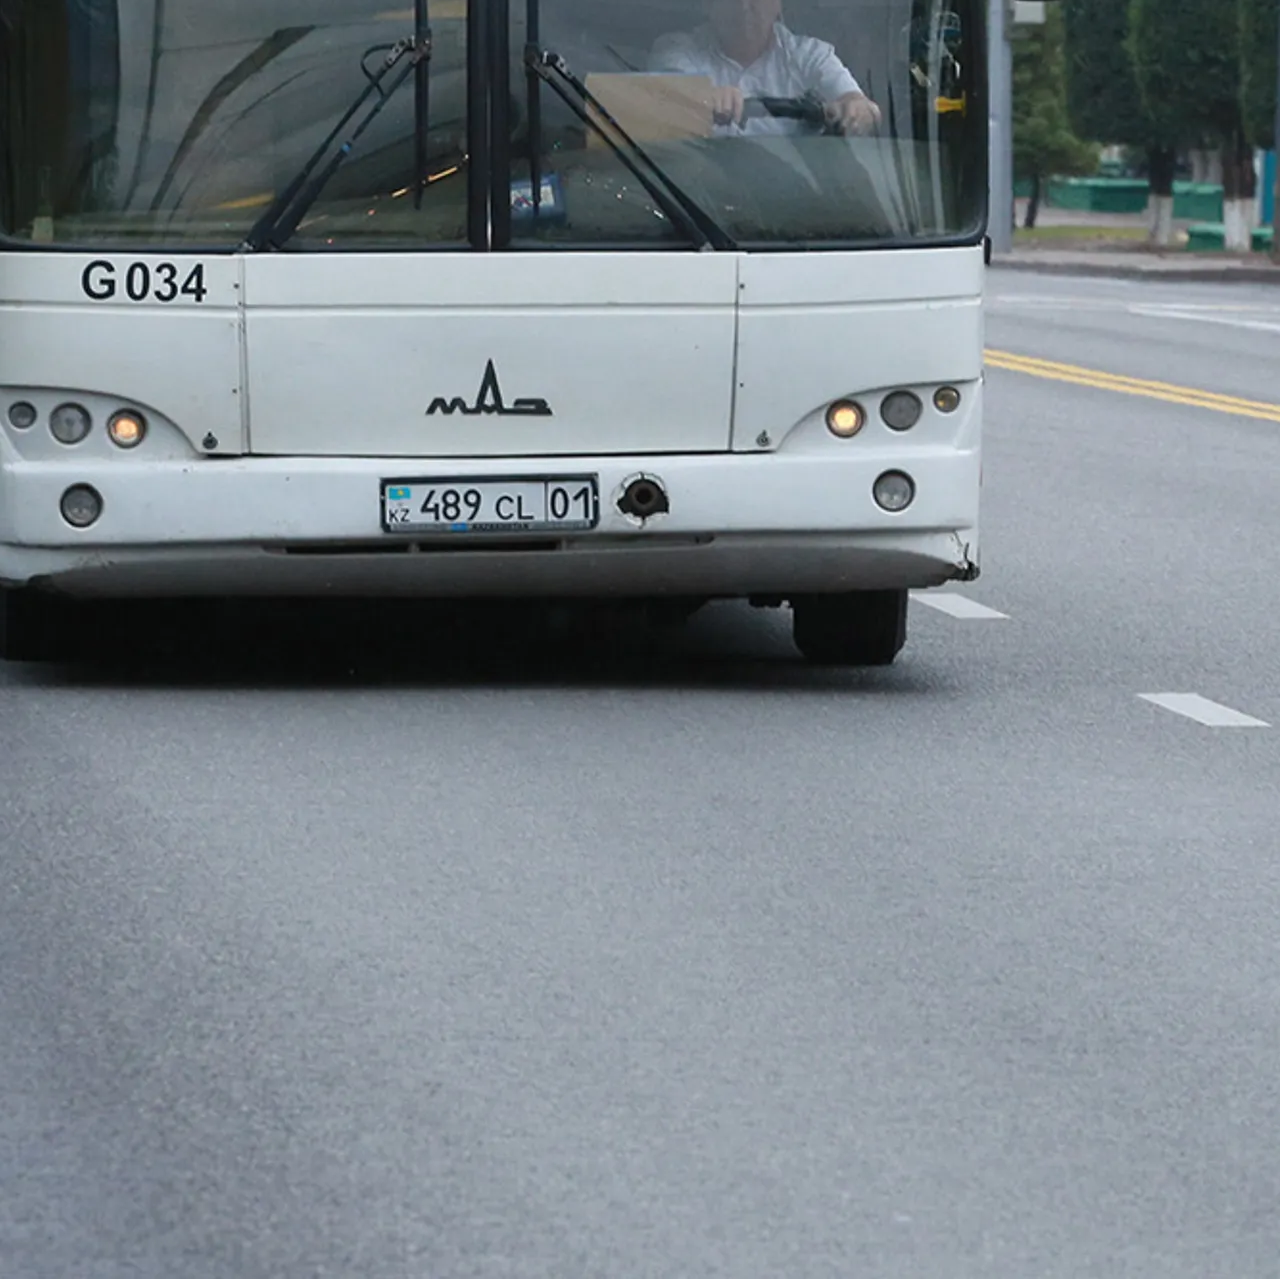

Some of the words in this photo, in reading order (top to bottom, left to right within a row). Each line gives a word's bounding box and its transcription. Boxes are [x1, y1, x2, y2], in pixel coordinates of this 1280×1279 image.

[388, 508, 411, 523] KZ
[420, 488, 482, 521] 489
[495, 495, 534, 521] CL
[550, 486, 590, 519] 01
